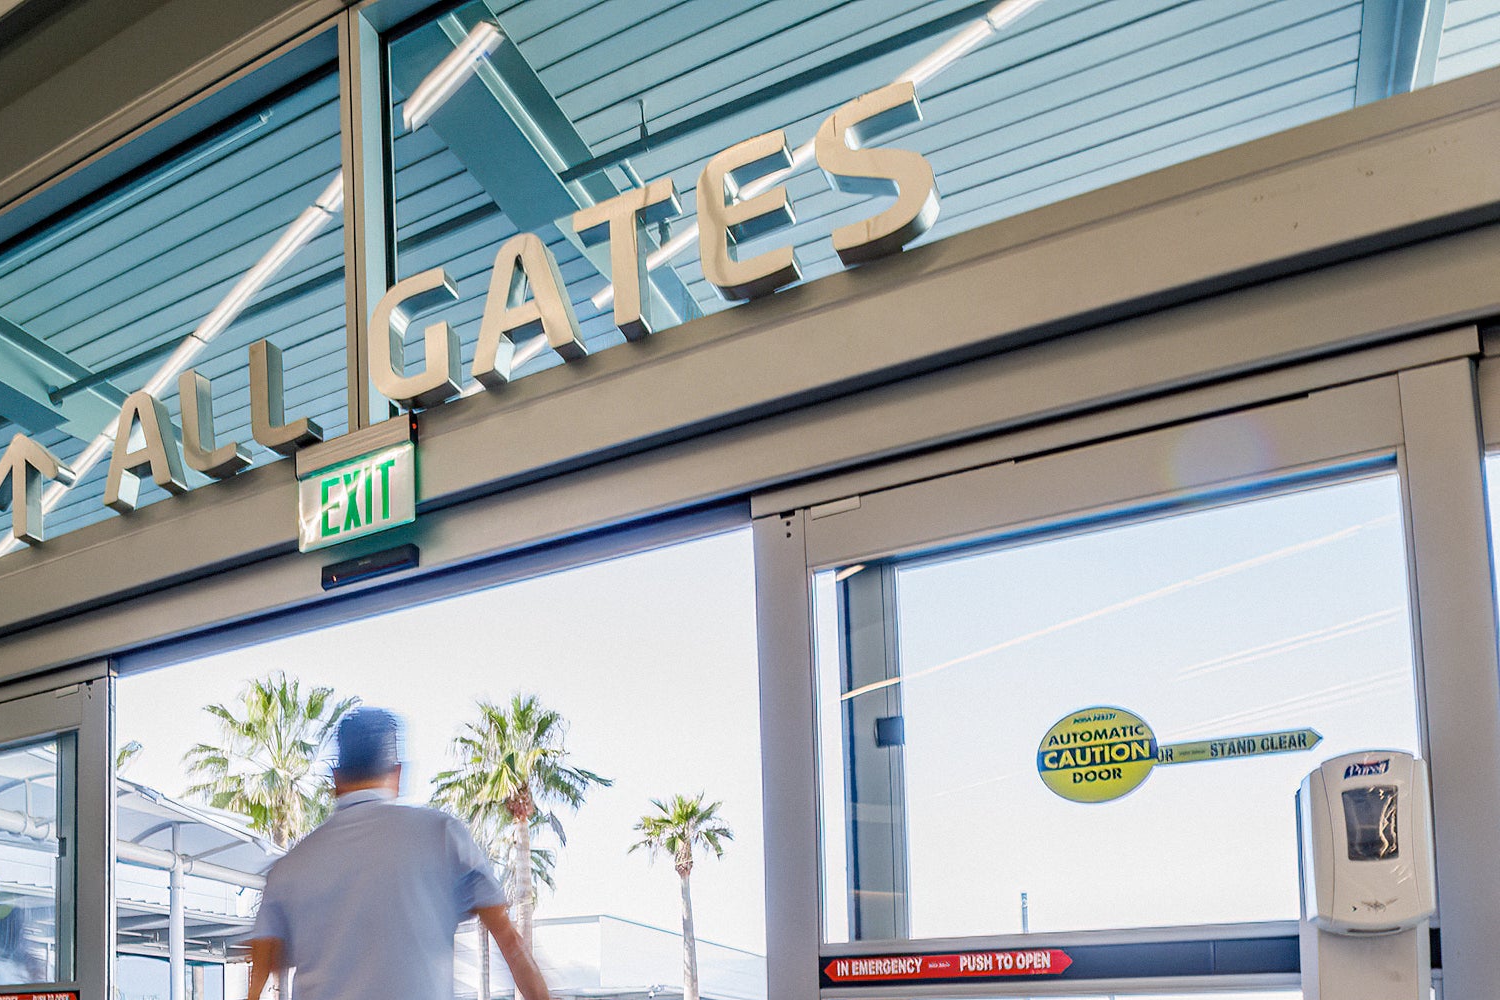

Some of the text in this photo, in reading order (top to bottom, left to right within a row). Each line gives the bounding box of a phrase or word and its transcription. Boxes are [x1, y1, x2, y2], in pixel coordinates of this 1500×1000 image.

[104, 81, 940, 512] ALL GATES
[321, 459, 396, 537] EXIT
[1048, 724, 1145, 746] AUTOMATIC
[1210, 739, 1257, 758] STAND
[1260, 732, 1307, 751] CLEAR
[1044, 740, 1151, 770] CAUTION
[1072, 768, 1122, 784] DOOR
[836, 960, 849, 977] IN
[851, 957, 923, 976] EMERGENCY
[959, 953, 993, 972] PUSH
[996, 952, 1013, 970] TO
[1017, 951, 1051, 970] OPEN
